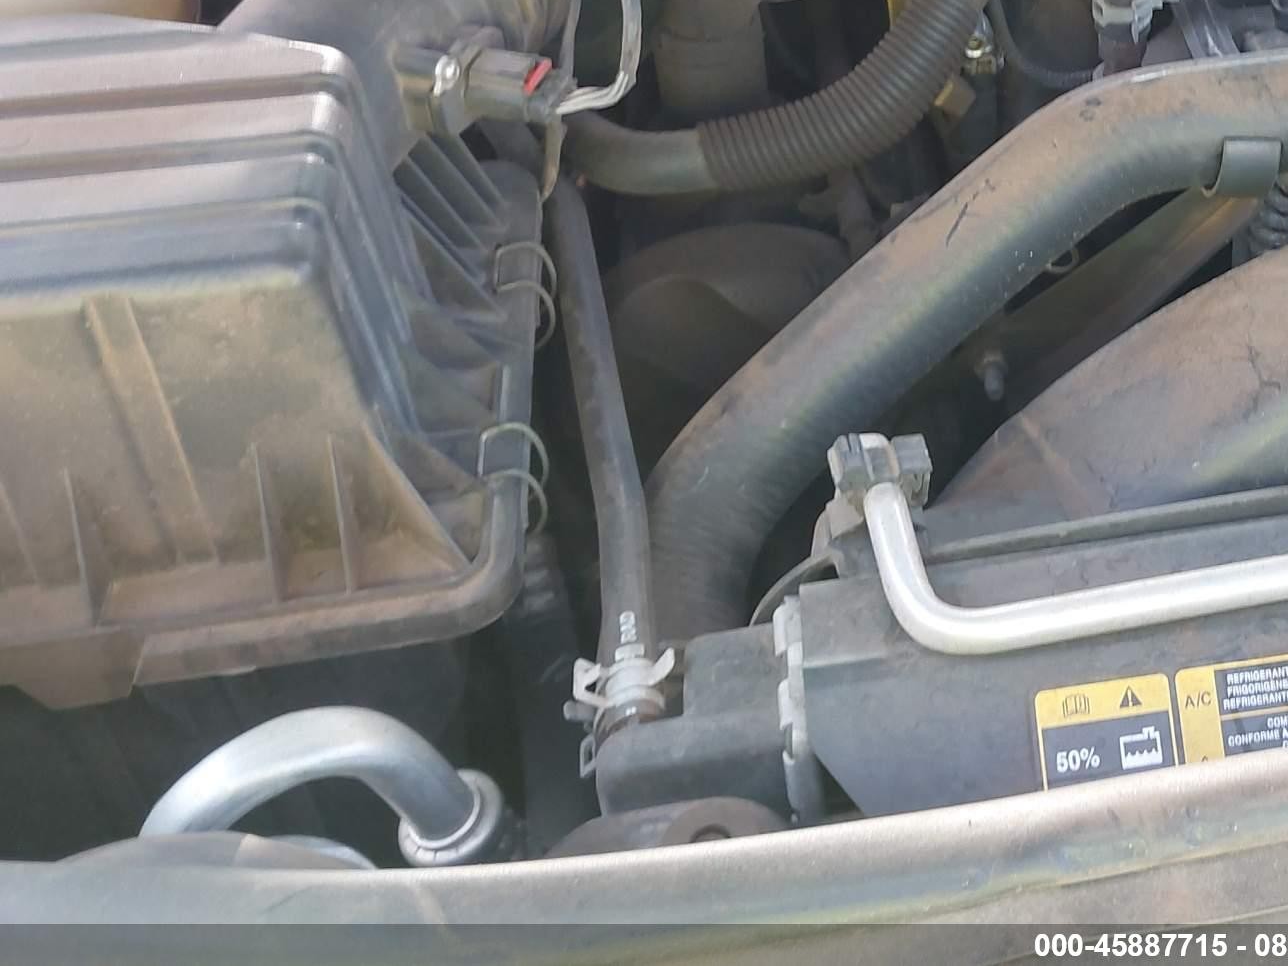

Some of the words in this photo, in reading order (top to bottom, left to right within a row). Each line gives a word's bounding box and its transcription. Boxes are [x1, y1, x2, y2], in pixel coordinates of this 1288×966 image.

[1184, 690, 1212, 710] A/C
[1228, 728, 1280, 746] CONFORME
[1056, 746, 1101, 774] 50%
